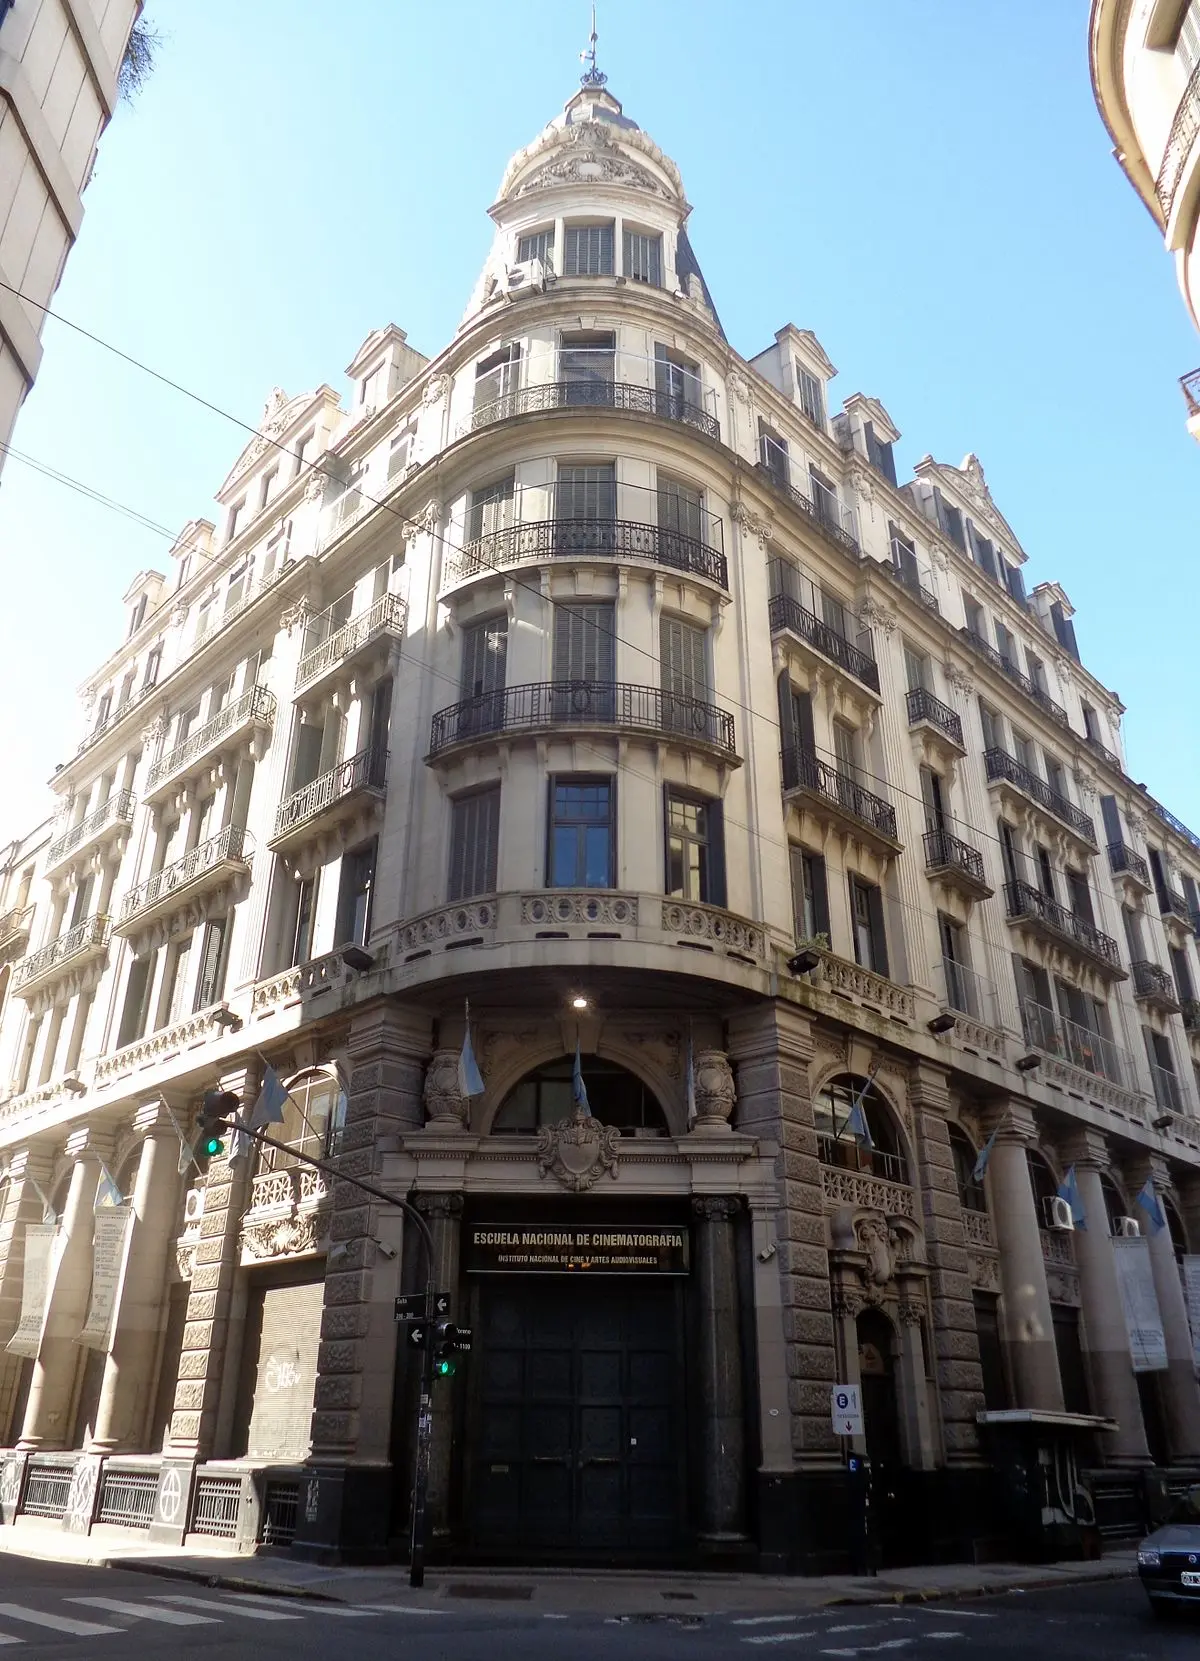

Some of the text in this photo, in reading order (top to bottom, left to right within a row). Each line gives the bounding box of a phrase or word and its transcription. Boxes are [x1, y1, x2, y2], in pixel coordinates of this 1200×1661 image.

[473, 1232, 682, 1247] ESCUELA NACIONAL DE CINEMATOGRAFIA
[498, 1254, 657, 1264] INSTITUTO NACIONAL DE CINE Y ARTES AUDIOVISUALES
[456, 1327, 472, 1335] oreno
